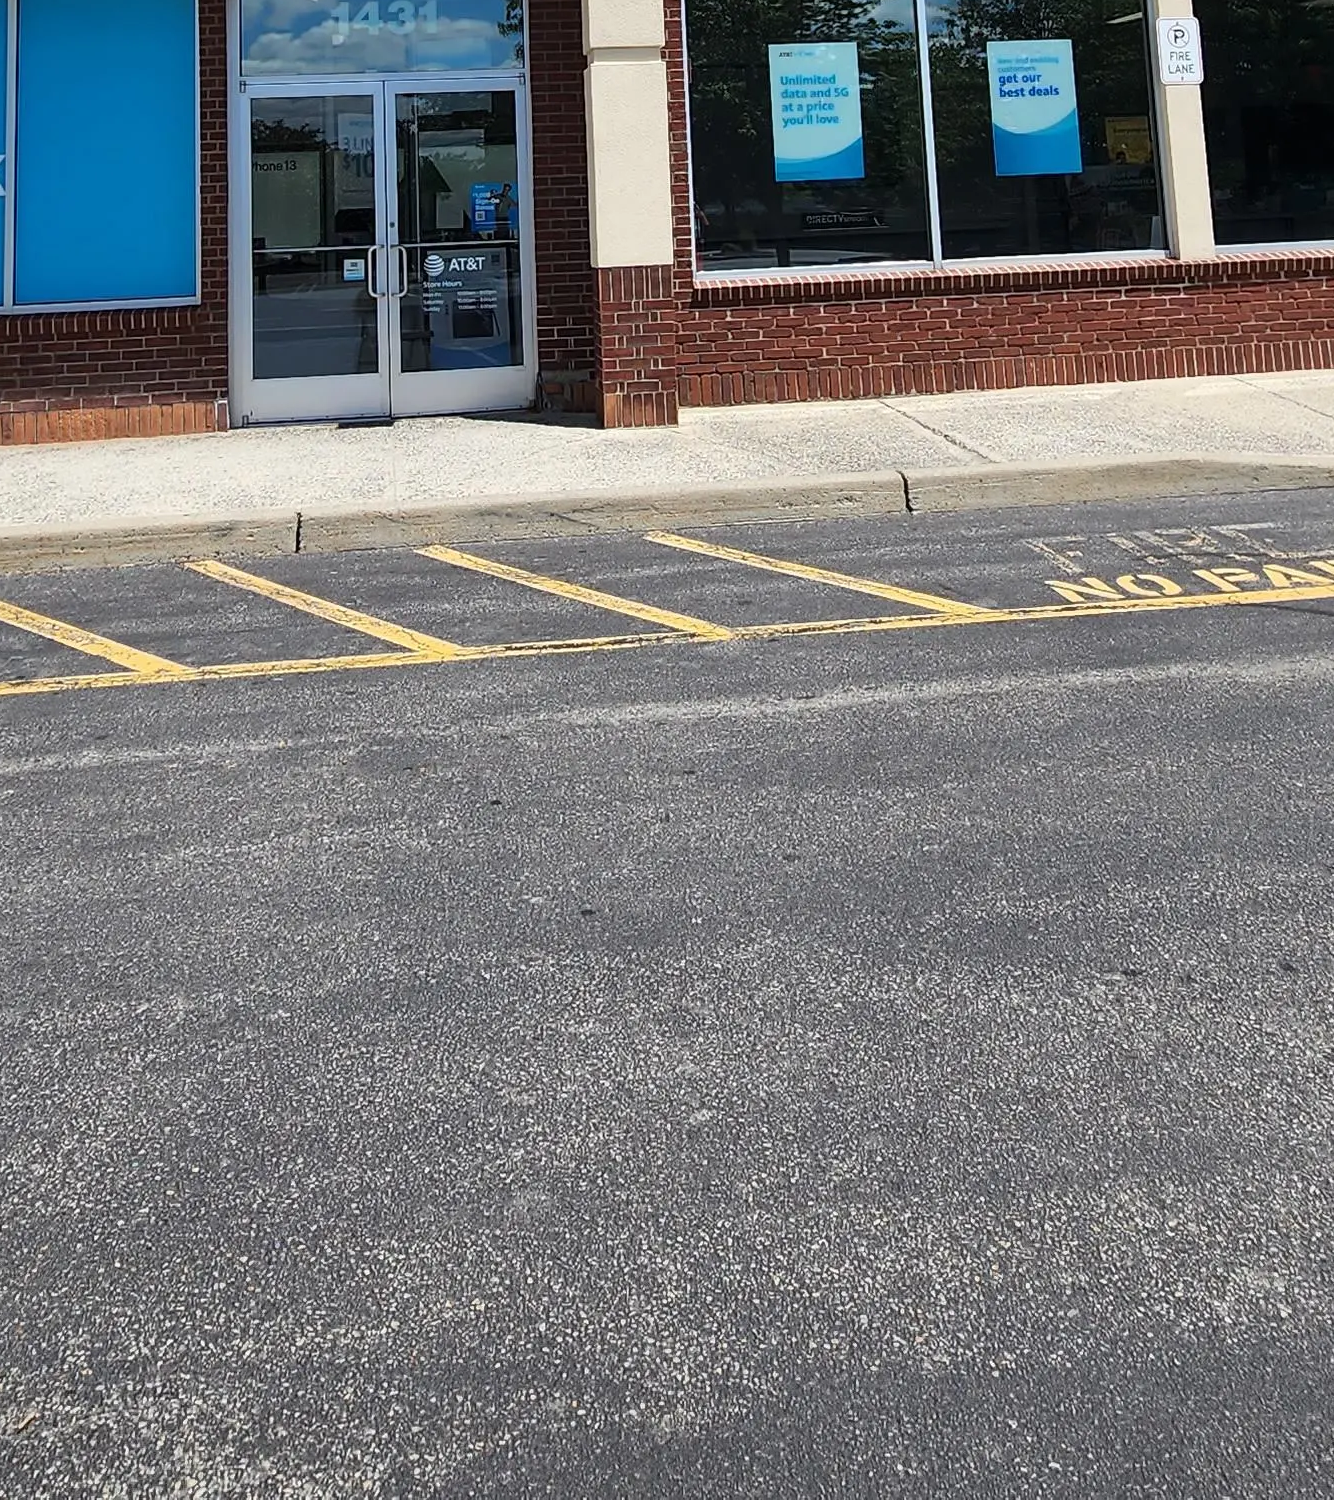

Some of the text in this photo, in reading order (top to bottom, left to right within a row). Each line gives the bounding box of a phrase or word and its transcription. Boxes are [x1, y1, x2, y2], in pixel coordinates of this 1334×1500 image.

[331, 0, 438, 36] 1431
[1170, 51, 1191, 61] FIRE
[1168, 63, 1195, 74] LANE
[780, 75, 836, 85] Unlimited
[998, 74, 1042, 86] get our
[781, 87, 849, 99] data and 5G
[999, 85, 1060, 98] best deals
[782, 101, 834, 113] at a price
[782, 114, 839, 128] you'll love
[285, 160, 297, 170] 13
[449, 257, 486, 271] AT&T
[1044, 573, 1184, 603] NO
